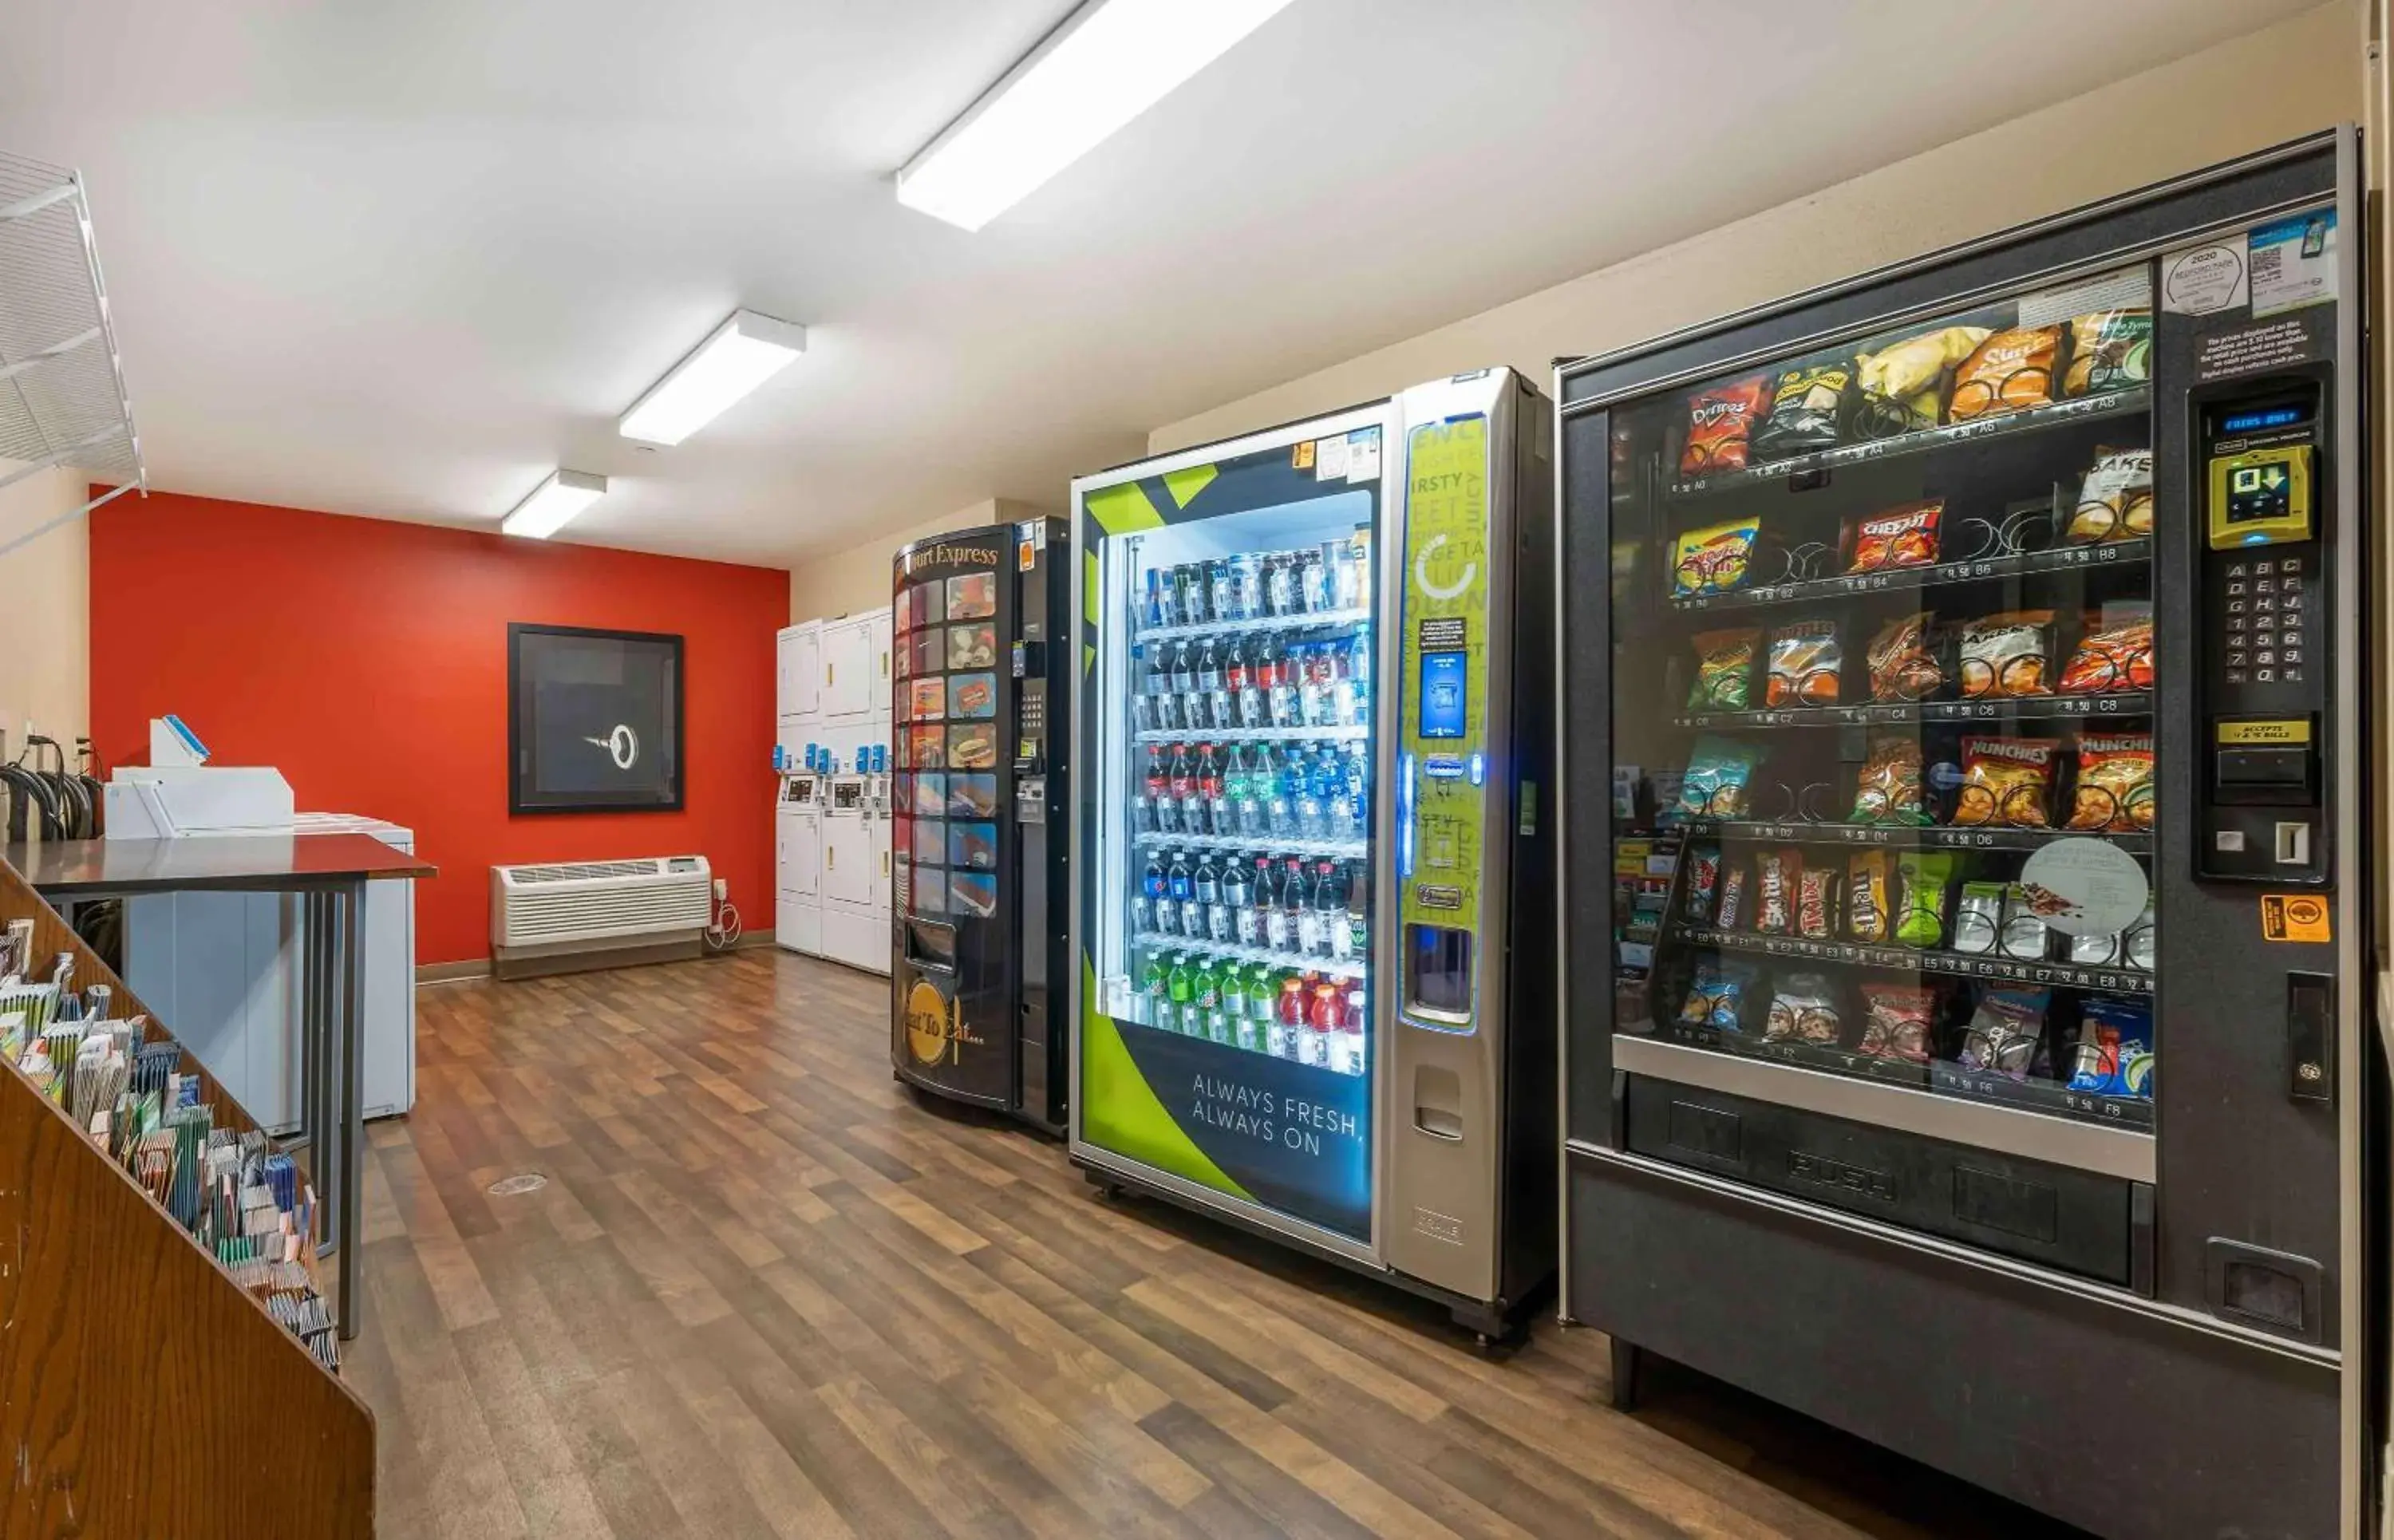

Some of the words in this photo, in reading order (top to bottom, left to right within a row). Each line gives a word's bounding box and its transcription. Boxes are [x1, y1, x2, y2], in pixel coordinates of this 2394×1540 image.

[2191, 251, 2217, 263] 2020
[2099, 397, 2115, 409] A8
[1692, 401, 1748, 426] Doritos
[1979, 423, 1994, 433] A6
[2089, 456, 2153, 474] BAKE
[936, 544, 998, 569] Express
[2230, 566, 2242, 575] A
[2256, 563, 2269, 573] B
[2283, 560, 2297, 570] C
[2230, 584, 2242, 594] D
[2258, 581, 2269, 591] E
[2284, 578, 2295, 589] F
[2230, 602, 2243, 611] G
[2256, 600, 2270, 610] H
[2284, 597, 2296, 607] J
[2234, 619, 2242, 629] 1
[2258, 617, 2270, 627] 2
[2285, 614, 2297, 626] 3
[2230, 636, 2242, 646] 4
[2257, 634, 2268, 645] 5
[2284, 633, 2297, 643] 6
[2232, 654, 2242, 665] 7
[2285, 651, 2297, 661] 9
[2258, 670, 2270, 681] 0
[1969, 740, 2050, 764] MUNCHIES
[1801, 877, 1825, 930] TWIX
[1924, 958, 1938, 969] E5
[2036, 969, 2051, 981] E7
[2100, 976, 2115, 988] E8
[1193, 1074, 1275, 1114] ALWAYS
[1193, 1100, 1274, 1142] ALWAYS
[1284, 1127, 1320, 1157] ON
[1791, 1155, 1893, 1198] PUSH
